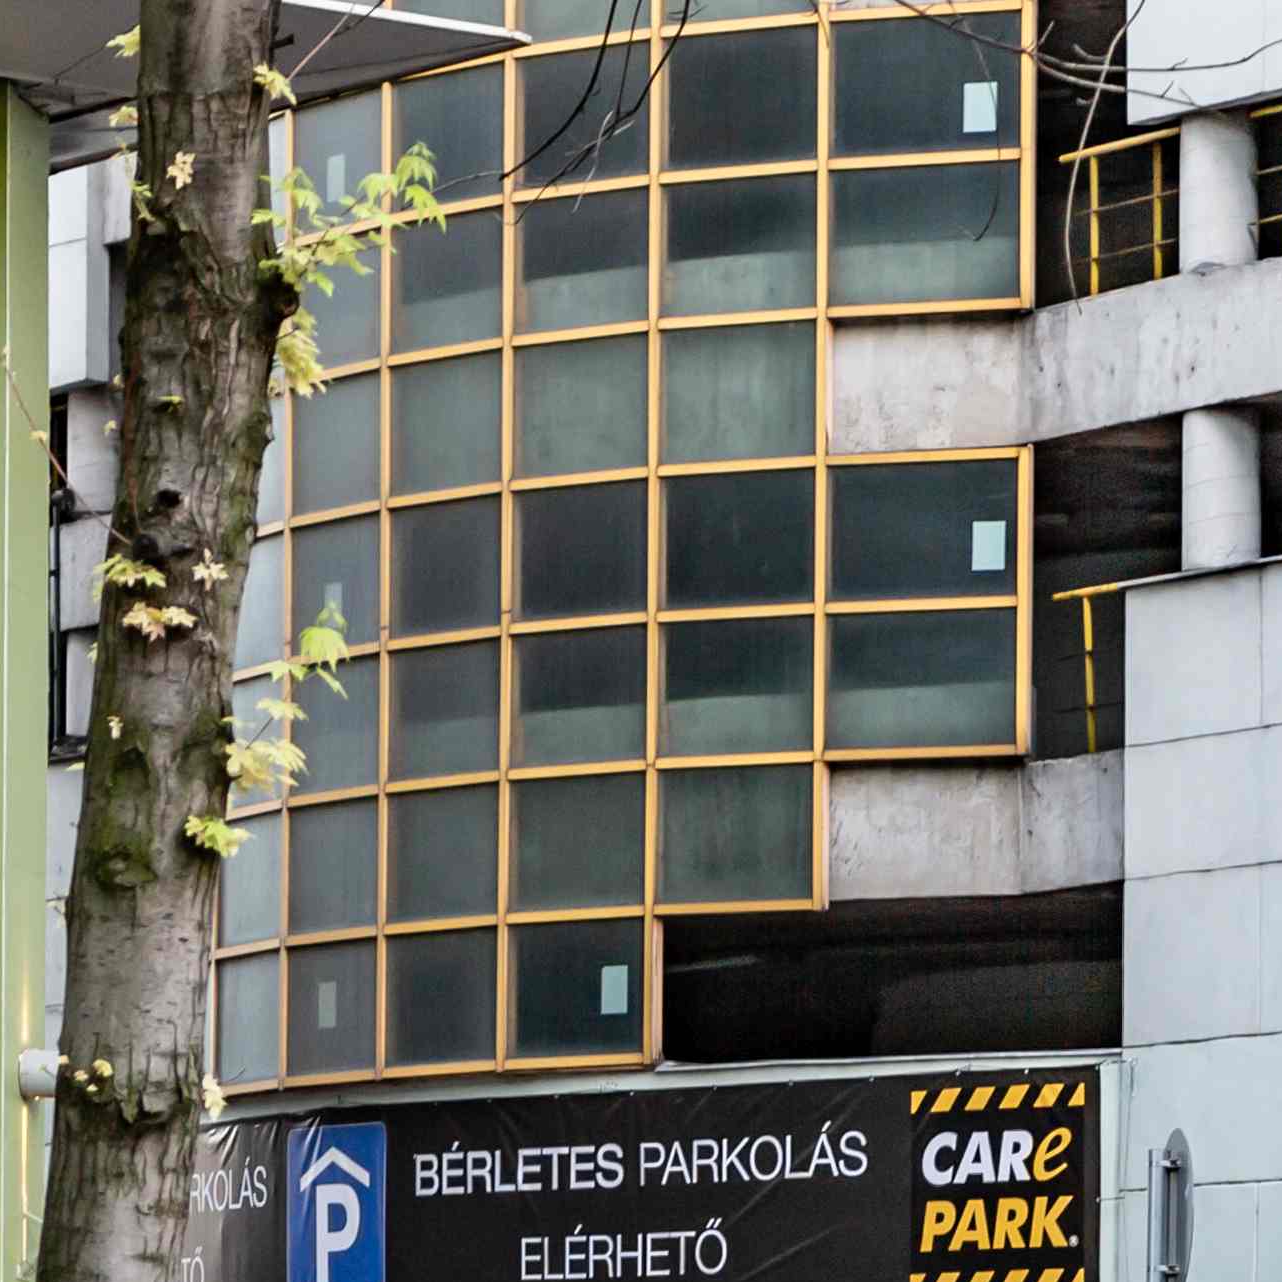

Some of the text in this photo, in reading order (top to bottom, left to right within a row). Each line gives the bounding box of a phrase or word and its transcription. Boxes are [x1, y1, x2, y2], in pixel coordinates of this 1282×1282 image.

[414, 1120, 869, 1197] BÉRLETES PARKOLÁS
[921, 1126, 1073, 1186] CARe
[520, 1217, 728, 1281] ELÉRHETŐ
[919, 1195, 1074, 1253] PARK
